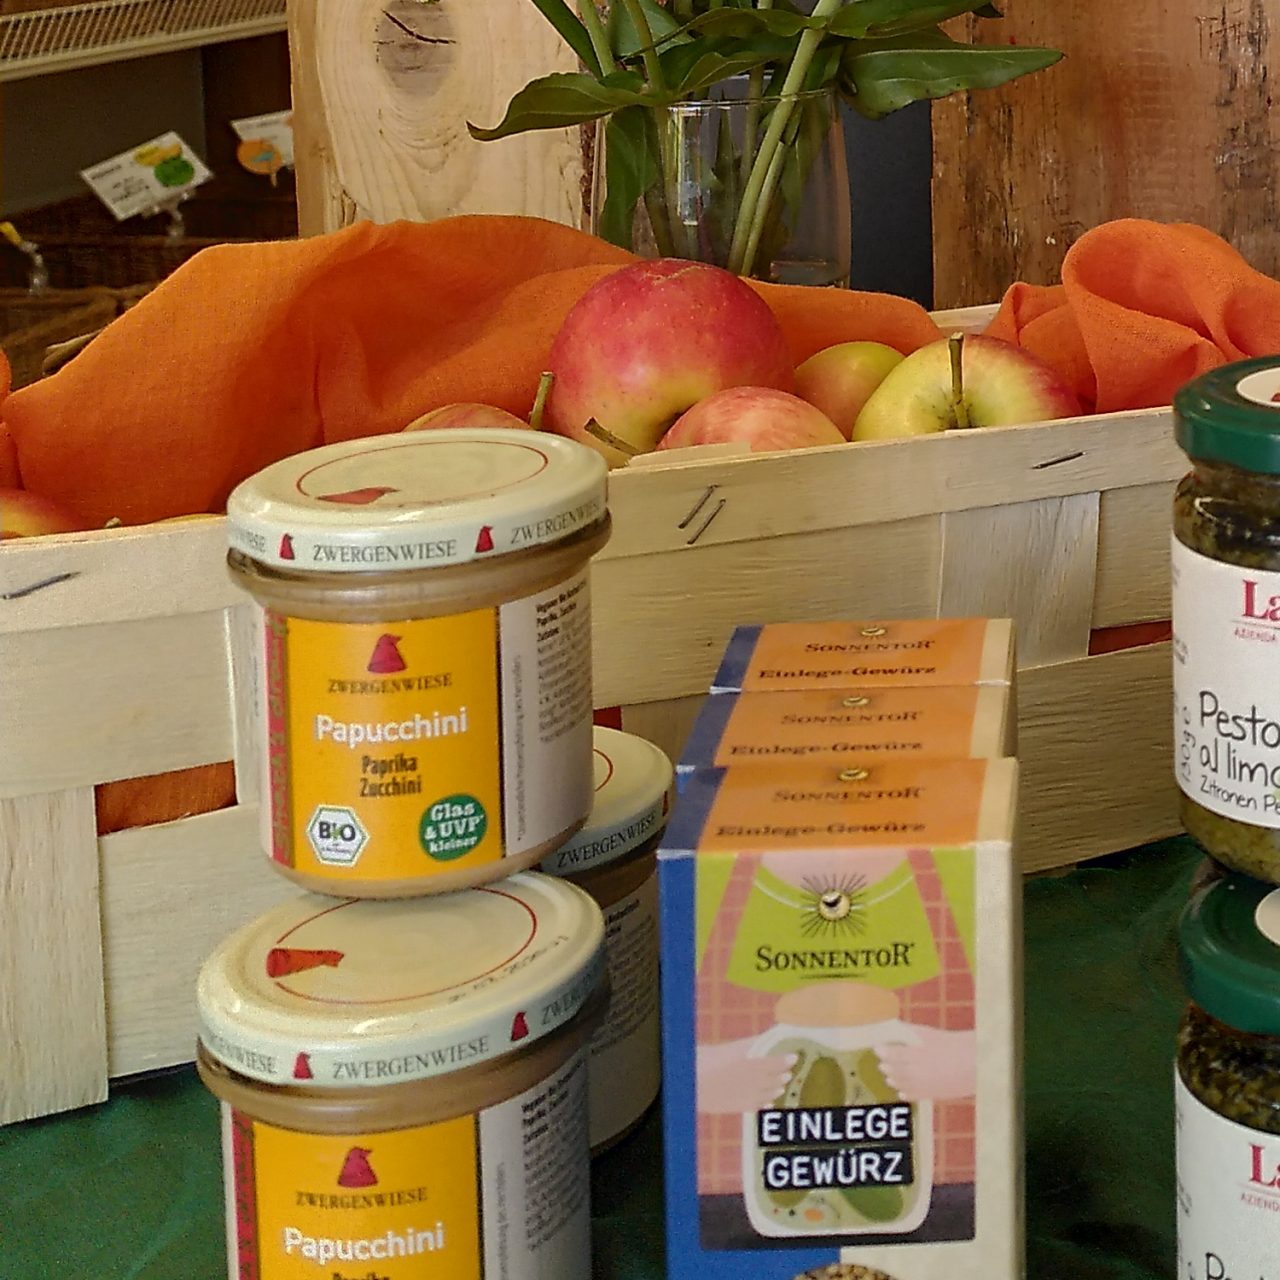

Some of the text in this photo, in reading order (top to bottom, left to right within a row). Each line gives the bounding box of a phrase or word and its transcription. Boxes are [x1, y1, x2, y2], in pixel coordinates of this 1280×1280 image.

[312, 539, 458, 564] ZWERGENWIESE
[327, 672, 453, 695] ZWERGENWIESE
[757, 665, 937, 680] Einlege-Gewürz
[315, 705, 468, 749] Papucchini
[361, 752, 418, 778] Paprika
[1199, 737, 1219, 774] al
[359, 775, 422, 798] Zucchini
[430, 802, 476, 822] Glas
[318, 821, 356, 842] BIO
[424, 825, 438, 840] &
[429, 836, 478, 854] kleiner
[755, 942, 912, 972] SONNENTOR
[332, 1034, 491, 1080] ZWERGENWIESE
[760, 1106, 910, 1144] EINLEGE
[765, 1149, 904, 1189] GEWÜRZ
[296, 1186, 428, 1210] ZWERGENWIESE
[282, 1220, 446, 1266] Papucchini
